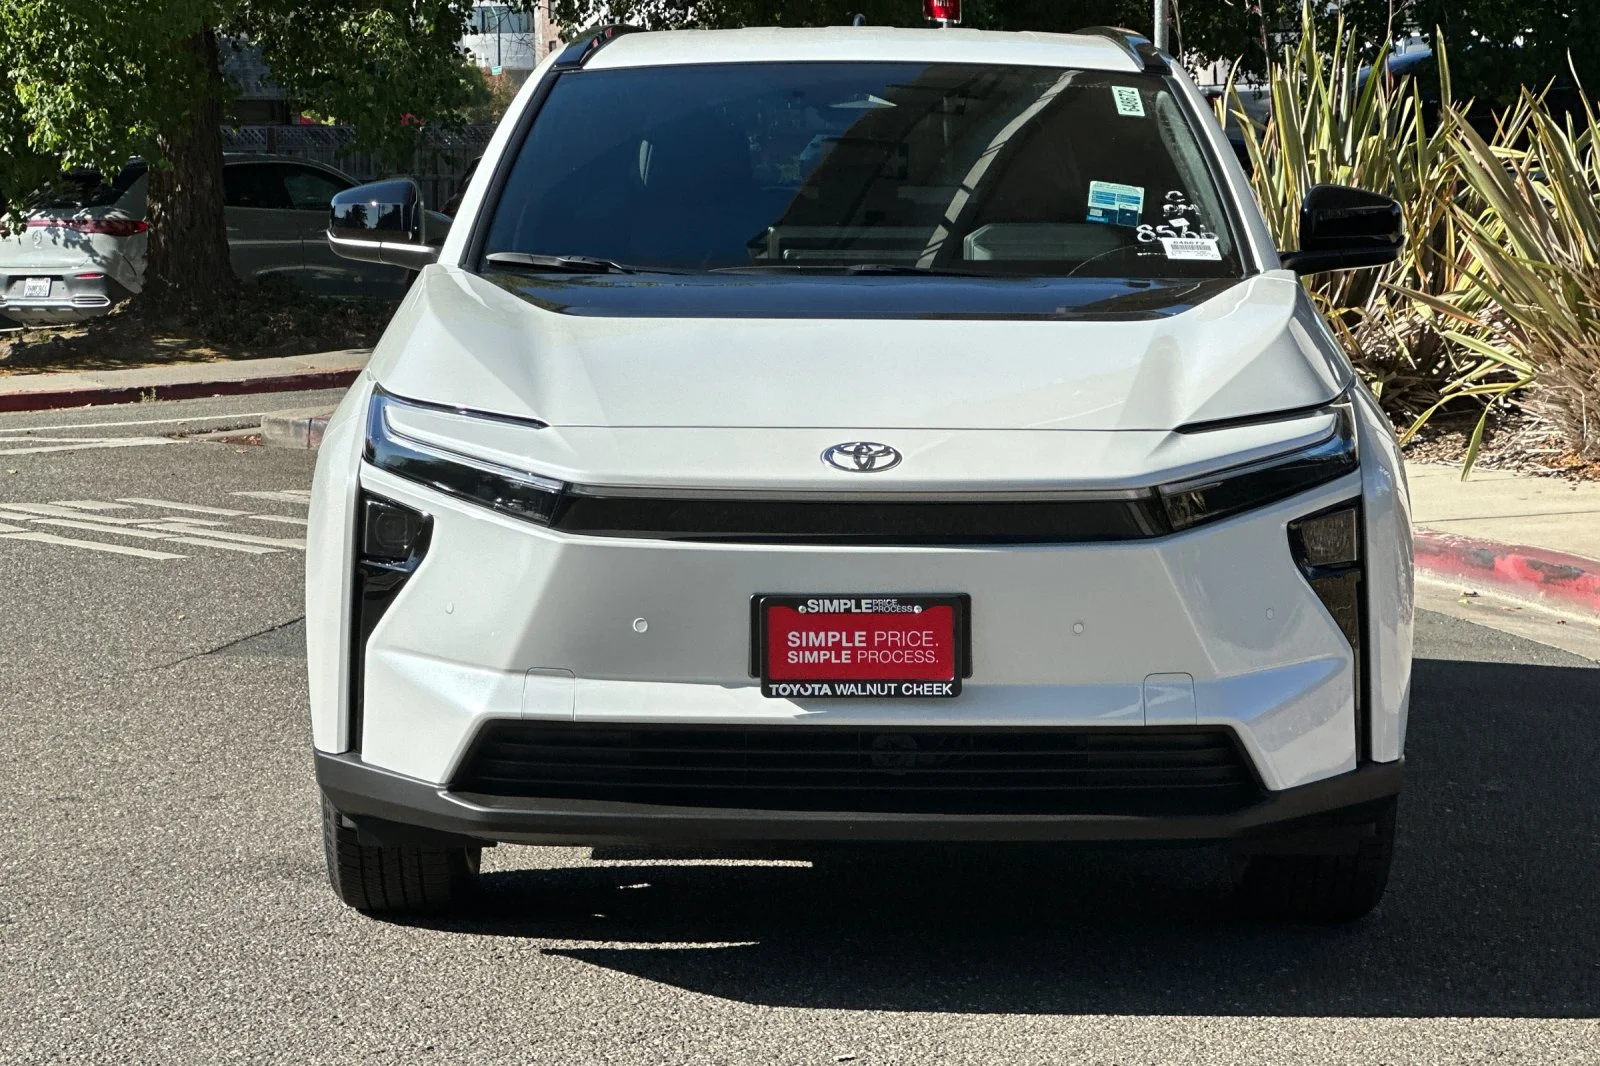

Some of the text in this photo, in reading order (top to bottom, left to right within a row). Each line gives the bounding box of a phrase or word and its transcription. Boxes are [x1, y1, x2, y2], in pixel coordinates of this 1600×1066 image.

[807, 599, 872, 613] SIMPLE
[787, 631, 939, 647] SIMPLE PRICE.
[787, 650, 939, 664] SIMPLE PROCESS.
[769, 683, 953, 696] TOYOTA WALNUT CREEK
